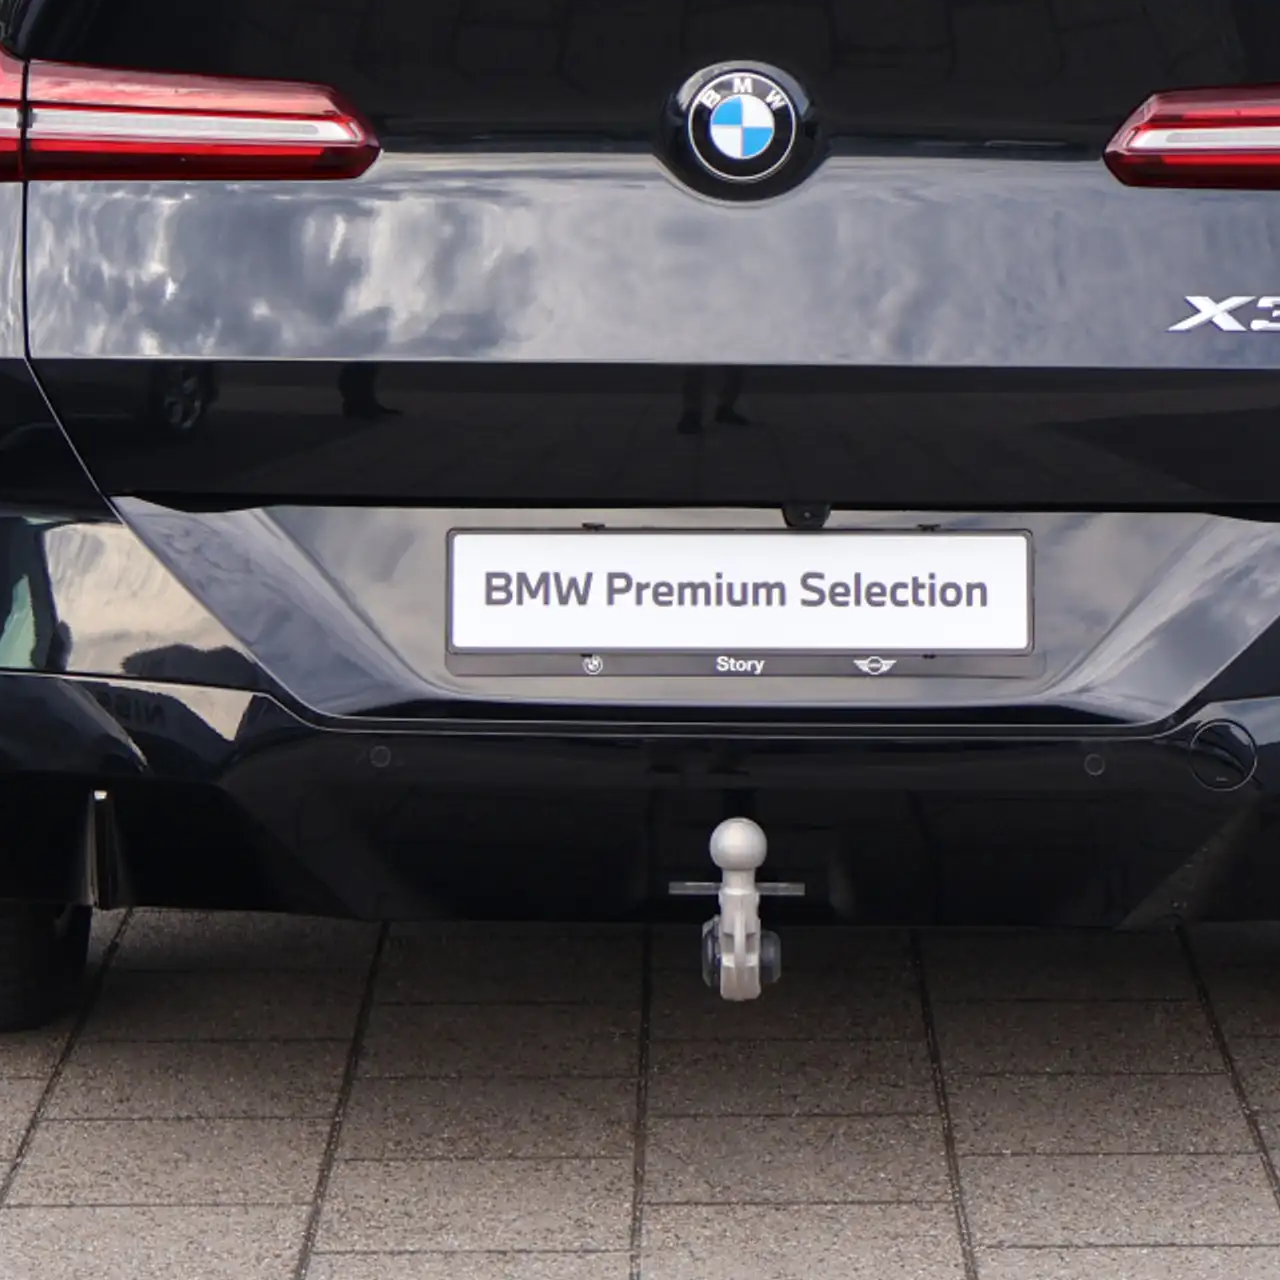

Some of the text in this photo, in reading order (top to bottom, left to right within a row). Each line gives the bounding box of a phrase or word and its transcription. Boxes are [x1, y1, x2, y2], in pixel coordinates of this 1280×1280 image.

[700, 78, 787, 110] BMW
[484, 571, 988, 608] BMW Premium Selection
[716, 656, 765, 675] Story
